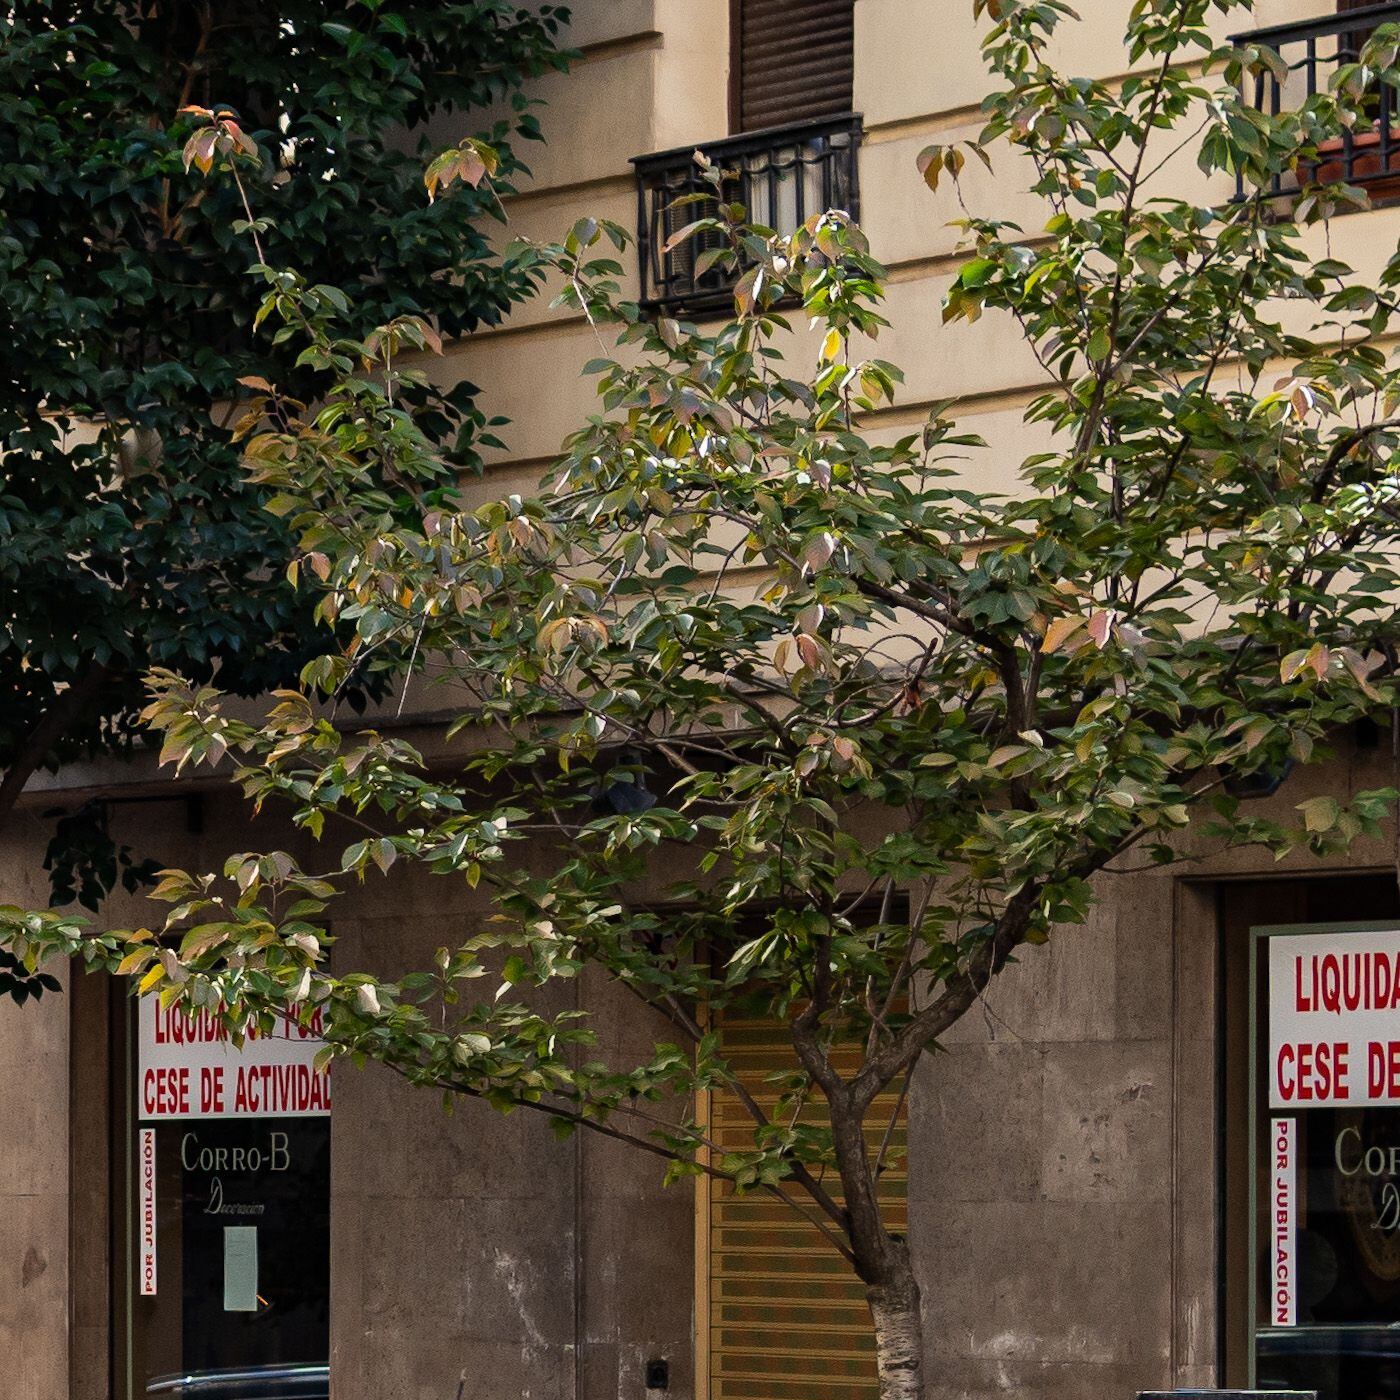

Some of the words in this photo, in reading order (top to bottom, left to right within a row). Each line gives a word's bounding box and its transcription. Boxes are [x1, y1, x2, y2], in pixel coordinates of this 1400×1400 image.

[144, 1067, 190, 1115] CESE
[201, 1067, 225, 1113] DE
[1277, 1042, 1349, 1100] CESE
[1276, 1121, 1288, 1170] POR
[144, 1252, 154, 1293] POR
[1276, 1177, 1292, 1324] JUBILACIÓN
